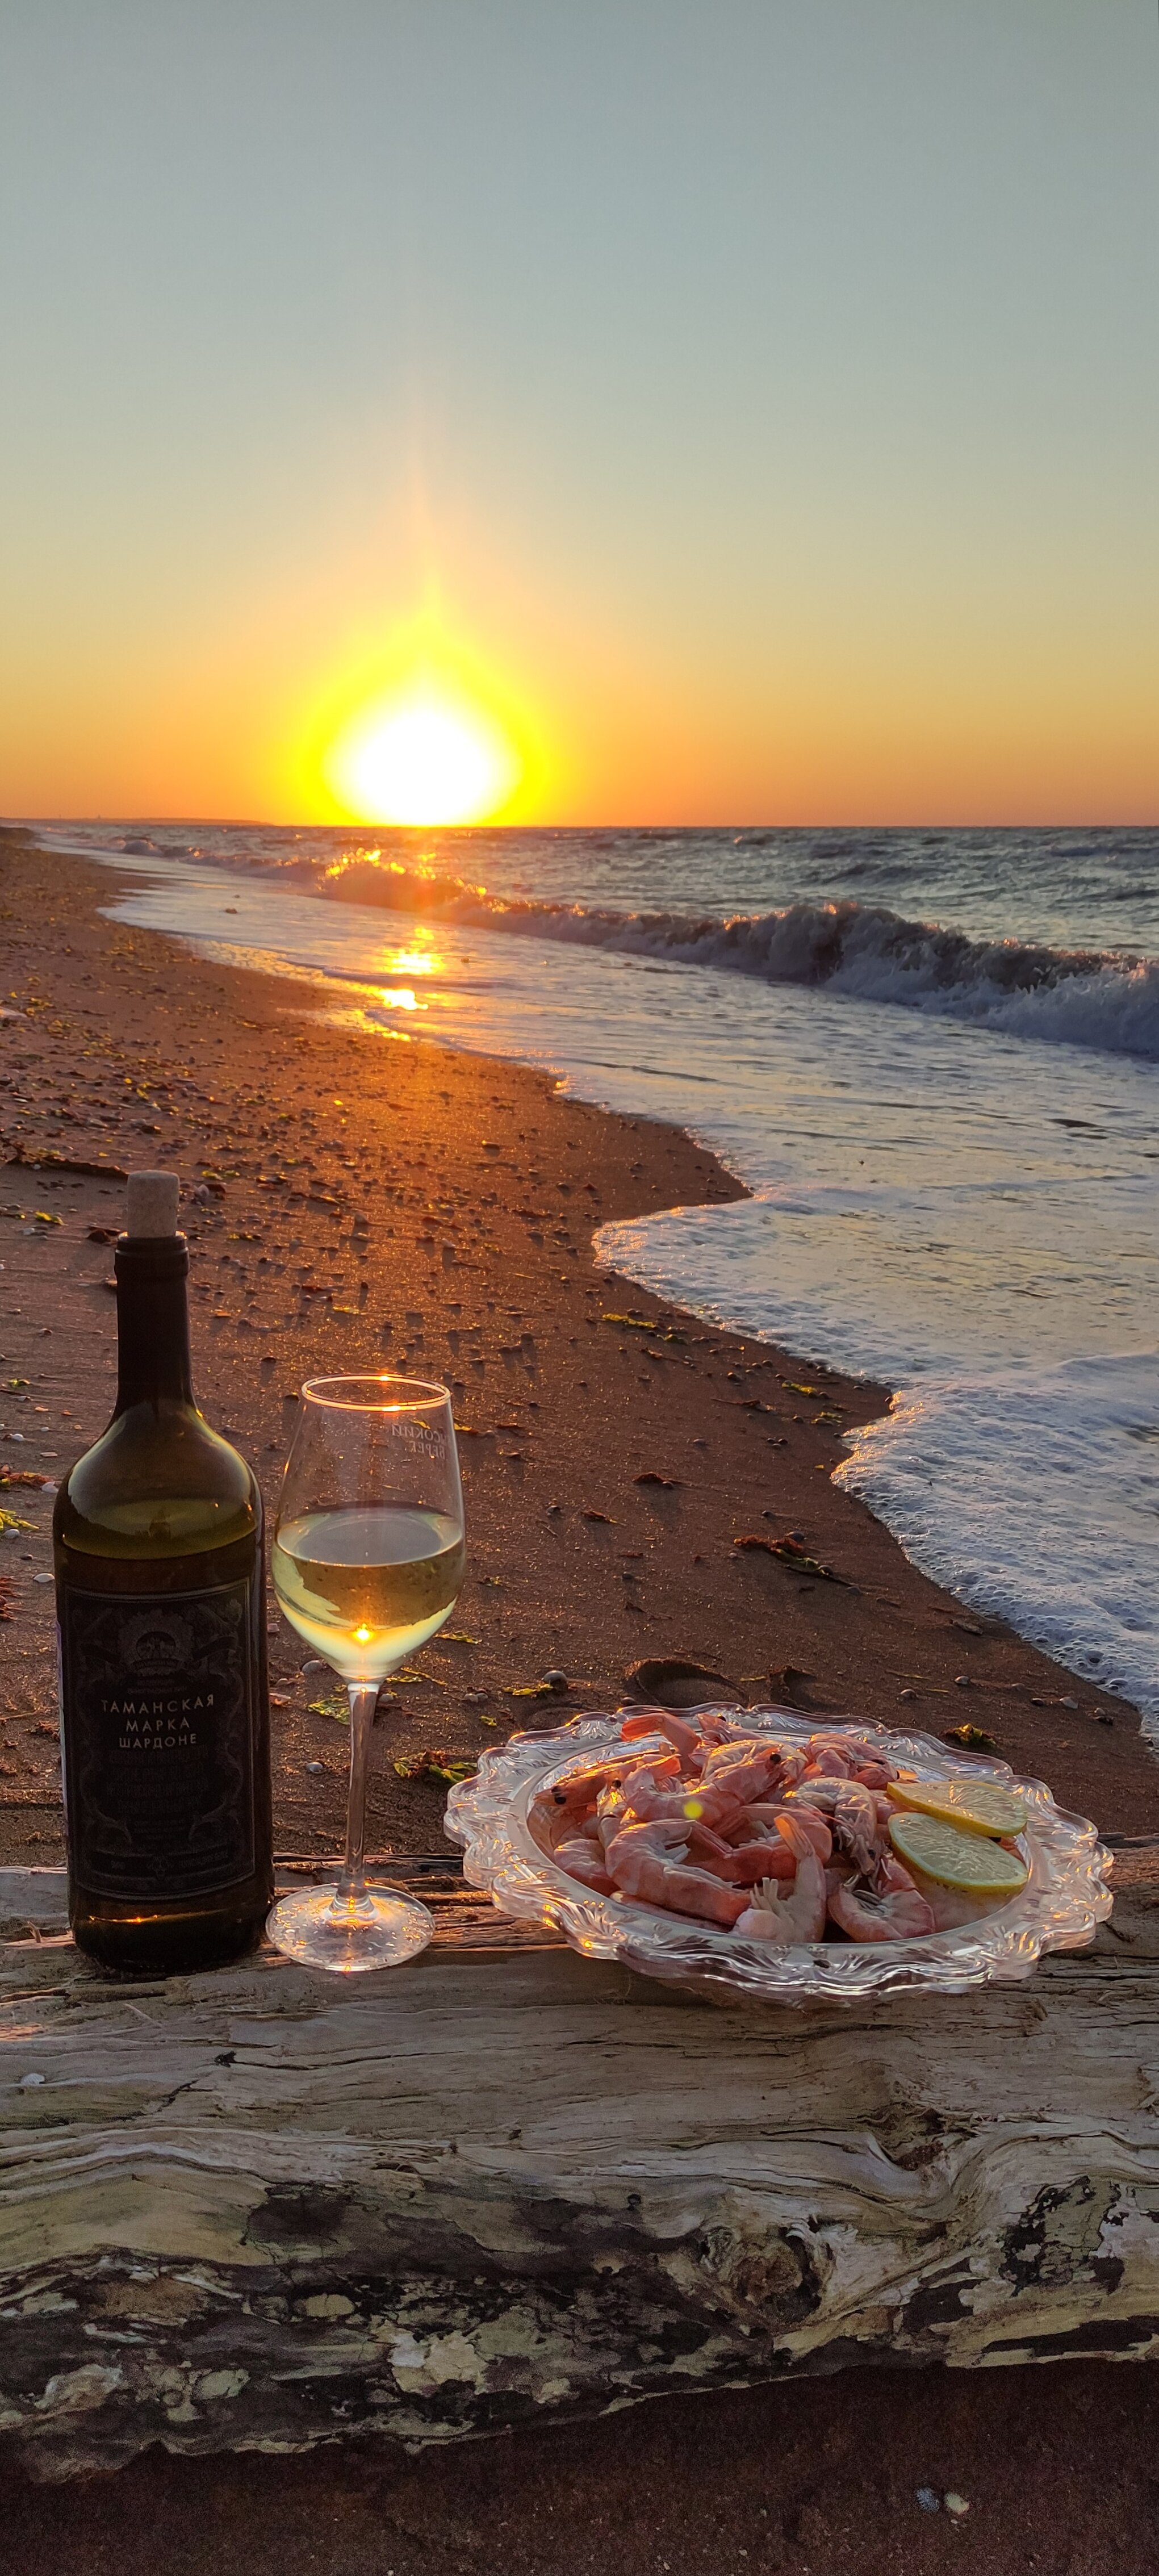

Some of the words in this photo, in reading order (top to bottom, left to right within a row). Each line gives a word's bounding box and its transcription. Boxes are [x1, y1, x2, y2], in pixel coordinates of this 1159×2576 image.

[101, 1693, 214, 1714] ТАМАНСКАЯ
[125, 1717, 190, 1732] МАРКА
[119, 1733, 197, 1749] ШАРДОНЕ
